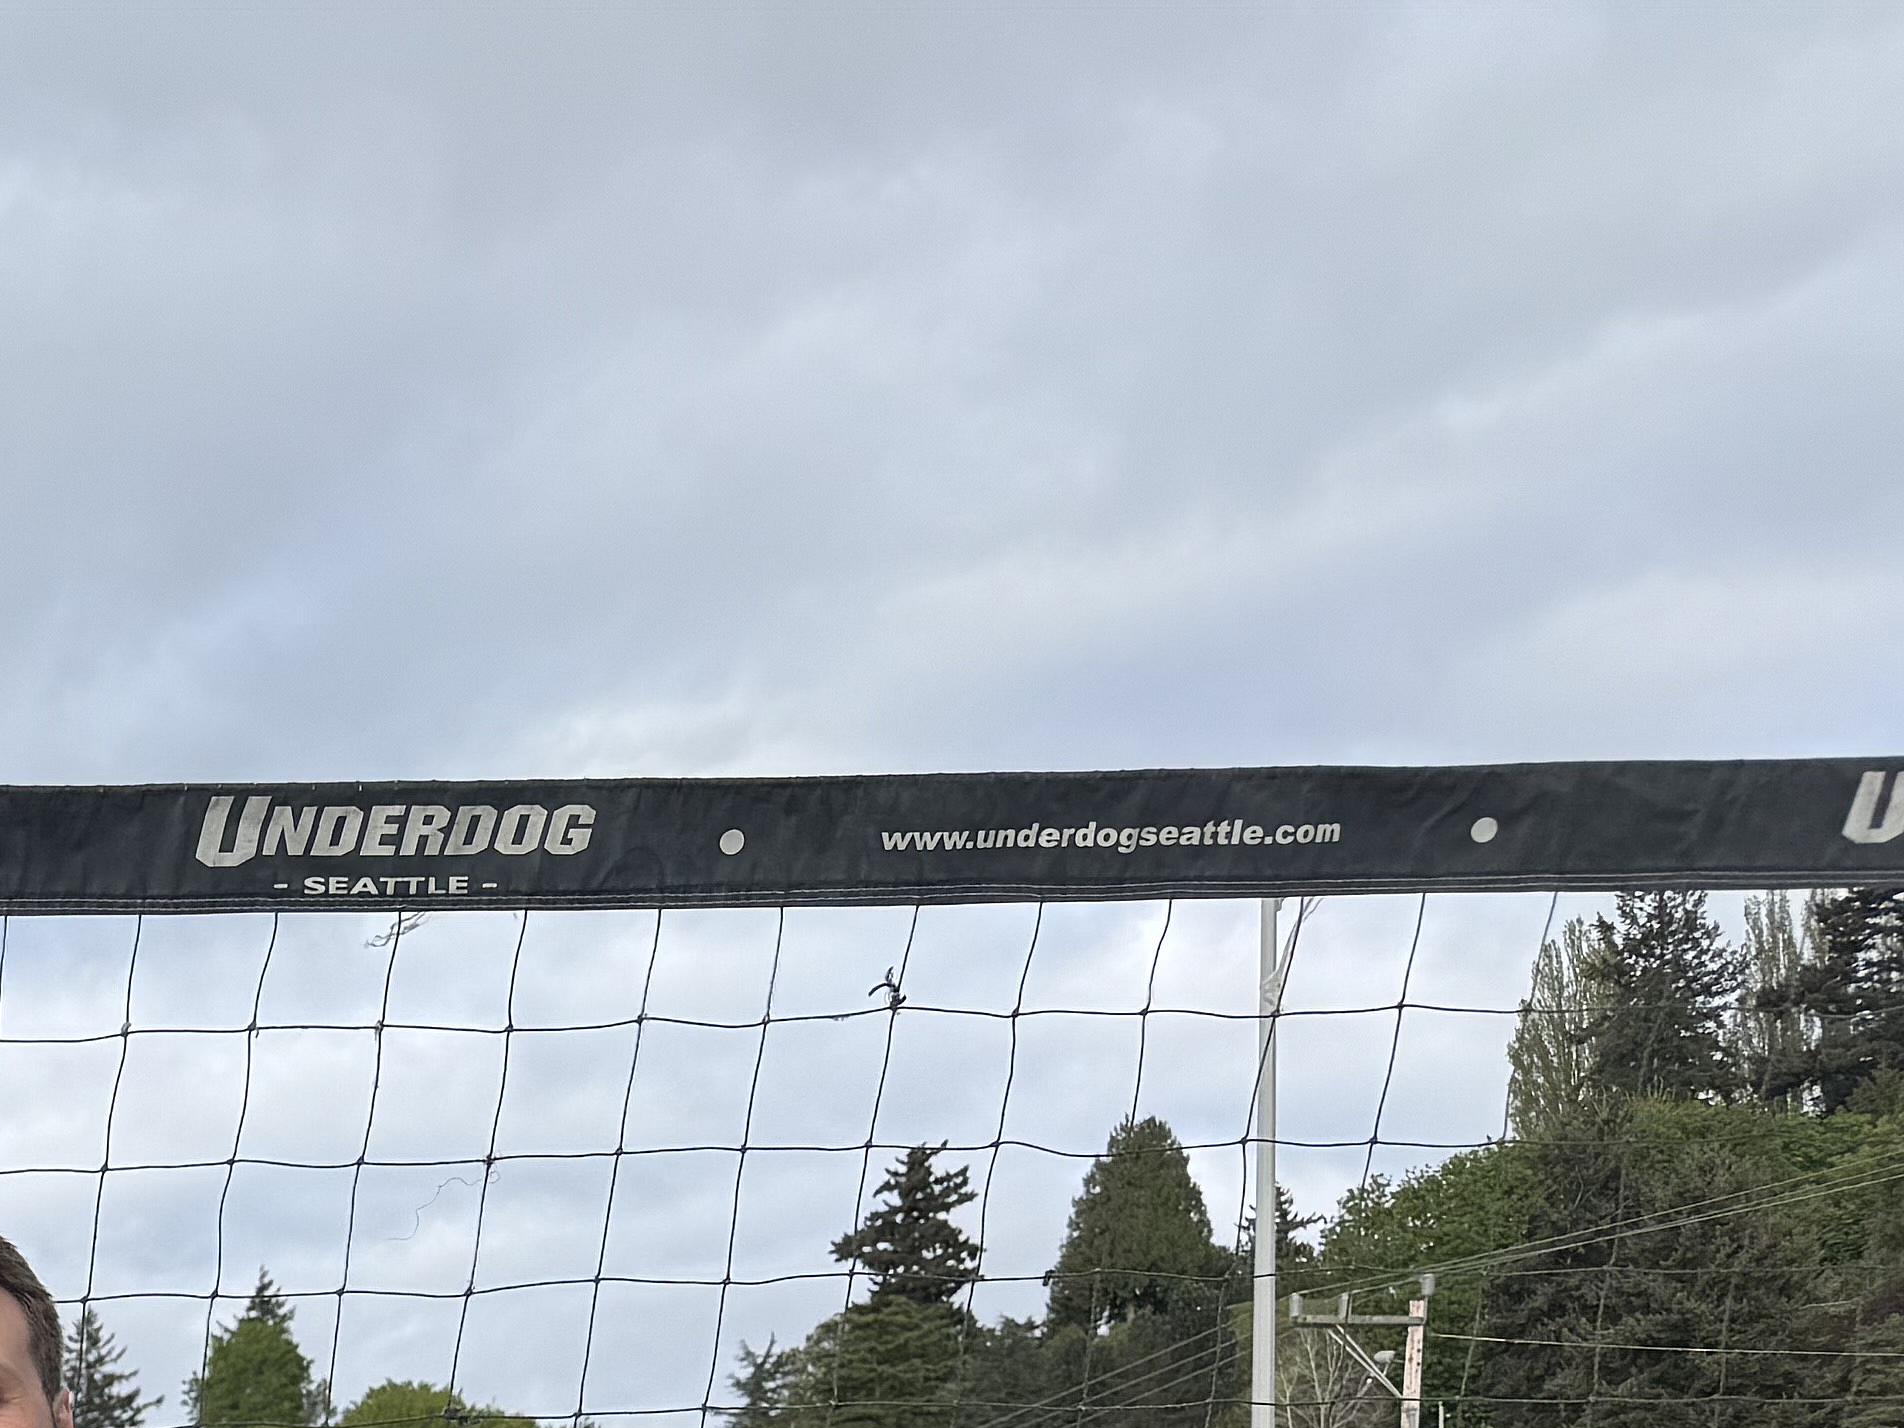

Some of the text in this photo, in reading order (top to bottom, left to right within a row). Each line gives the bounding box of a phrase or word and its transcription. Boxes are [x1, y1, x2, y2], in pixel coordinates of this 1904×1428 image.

[195, 795, 597, 868] UNDERDOG
[881, 819, 1341, 854] www.underdogseattle.com
[303, 875, 469, 895] SEATTLE
